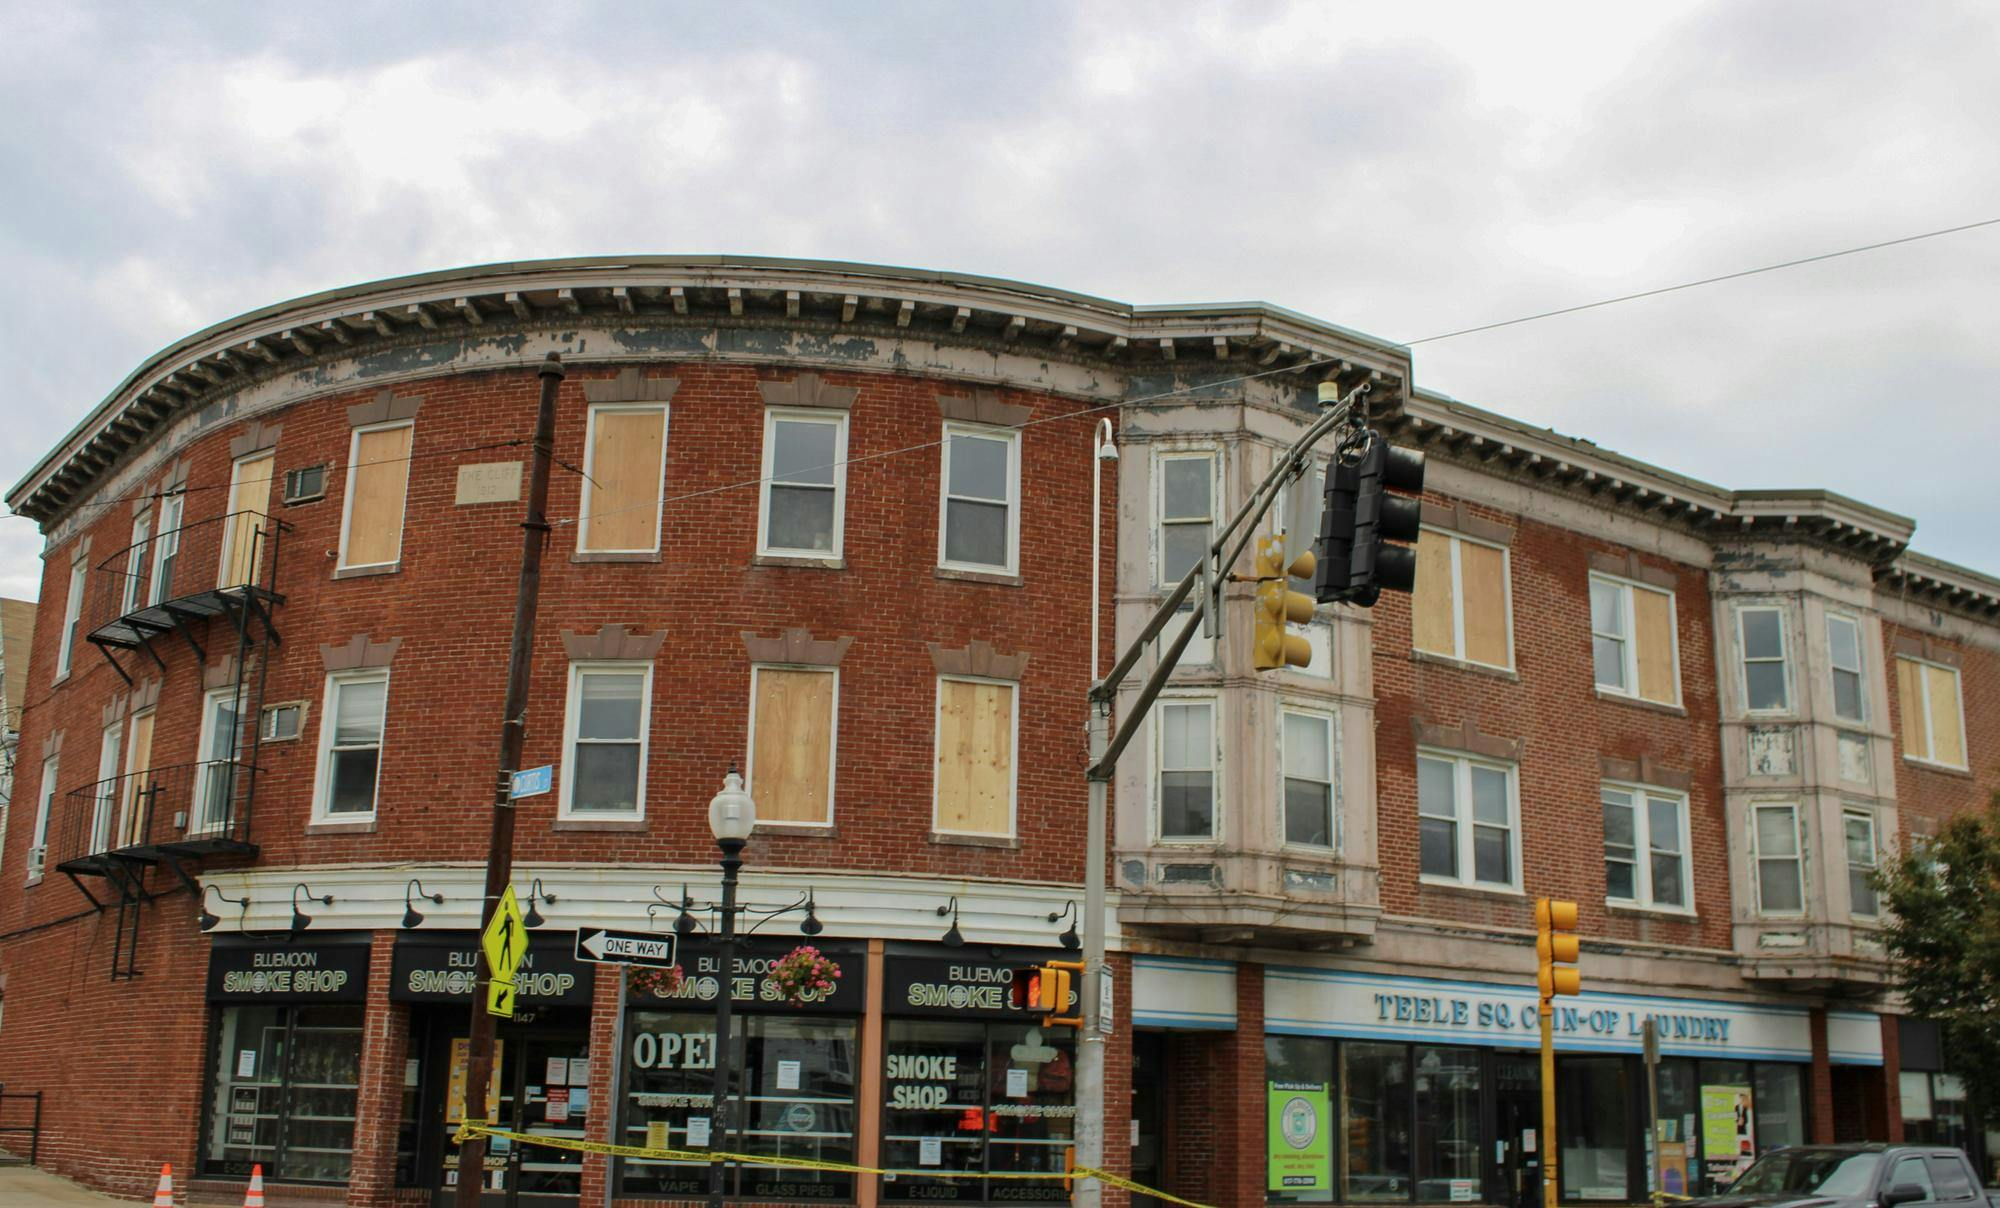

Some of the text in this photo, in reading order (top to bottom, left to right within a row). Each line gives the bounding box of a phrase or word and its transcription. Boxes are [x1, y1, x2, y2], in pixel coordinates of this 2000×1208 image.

[606, 939, 664, 956] ONE WAY
[253, 952, 317, 967] BLUEMOON
[448, 952, 533, 968] BLUN
[698, 957, 778, 974] BLEMOO
[223, 969, 347, 993] SMOKE SHOP
[408, 970, 478, 995] SMOK
[949, 965, 1013, 984] BLUEMO
[760, 978, 837, 1002] SOP
[908, 982, 1003, 1009] SMOKE
[513, 1013, 536, 1023] 1147
[1374, 993, 1469, 1026] TEELE
[1478, 1001, 1515, 1029] SQ.
[1627, 1011, 1730, 1041] LUNDRY
[886, 1055, 957, 1080] SMOKE
[893, 1085, 948, 1110] SHOP
[584, 1143, 612, 1153] CAUTION
[654, 1150, 681, 1158] CAUTION
[659, 1181, 699, 1193] VAPE
[756, 1184, 834, 1197] GLASS PIPES
[909, 1185, 958, 1198] E-LIQUID
[993, 1188, 1069, 1201] ACCESSORIE
